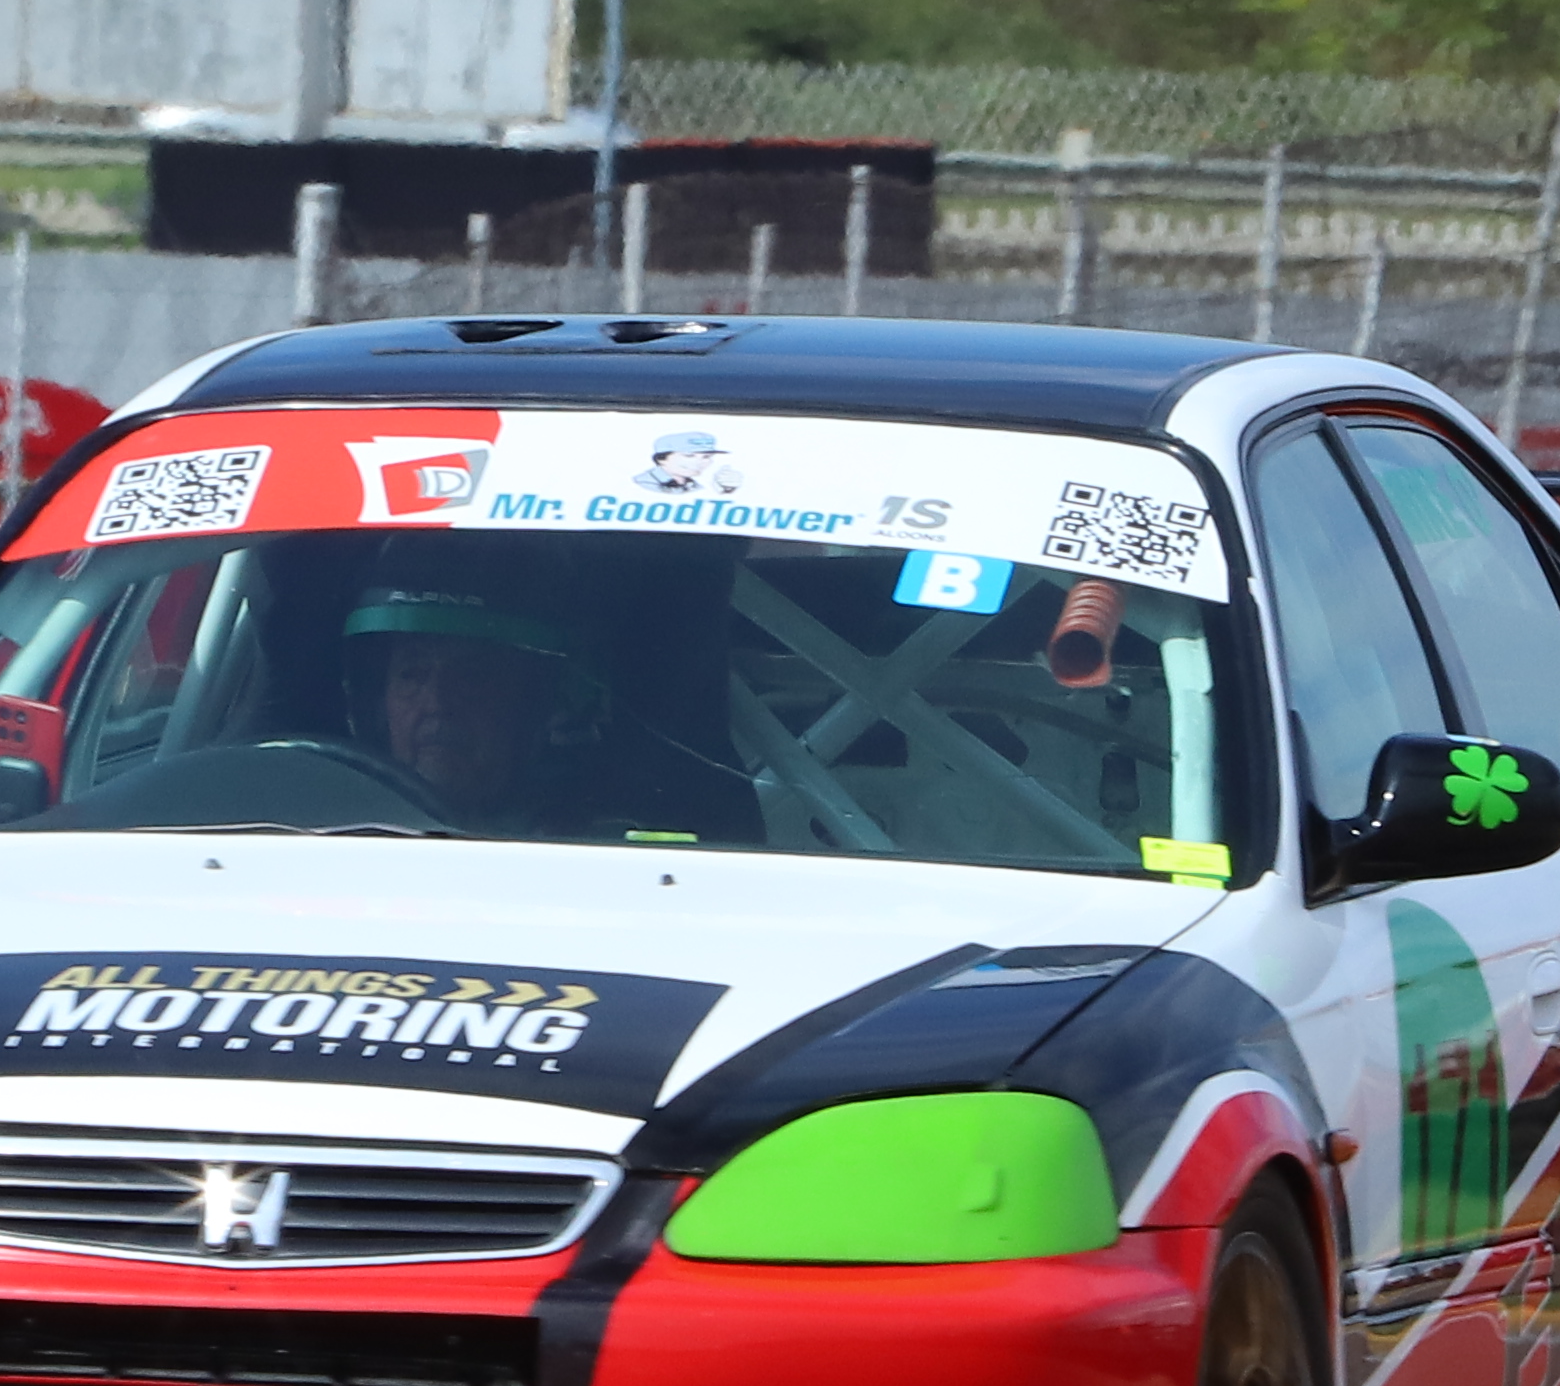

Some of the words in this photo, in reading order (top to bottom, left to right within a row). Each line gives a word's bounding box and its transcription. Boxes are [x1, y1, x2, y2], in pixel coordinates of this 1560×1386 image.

[489, 493, 565, 521] Mr.
[584, 494, 855, 534] GoodTower
[916, 552, 983, 609] B
[42, 965, 170, 991] ALL
[190, 965, 438, 997] THINGS
[15, 989, 590, 1054] MOTORING
[3, 1034, 563, 1073] INTERNATIONAL
